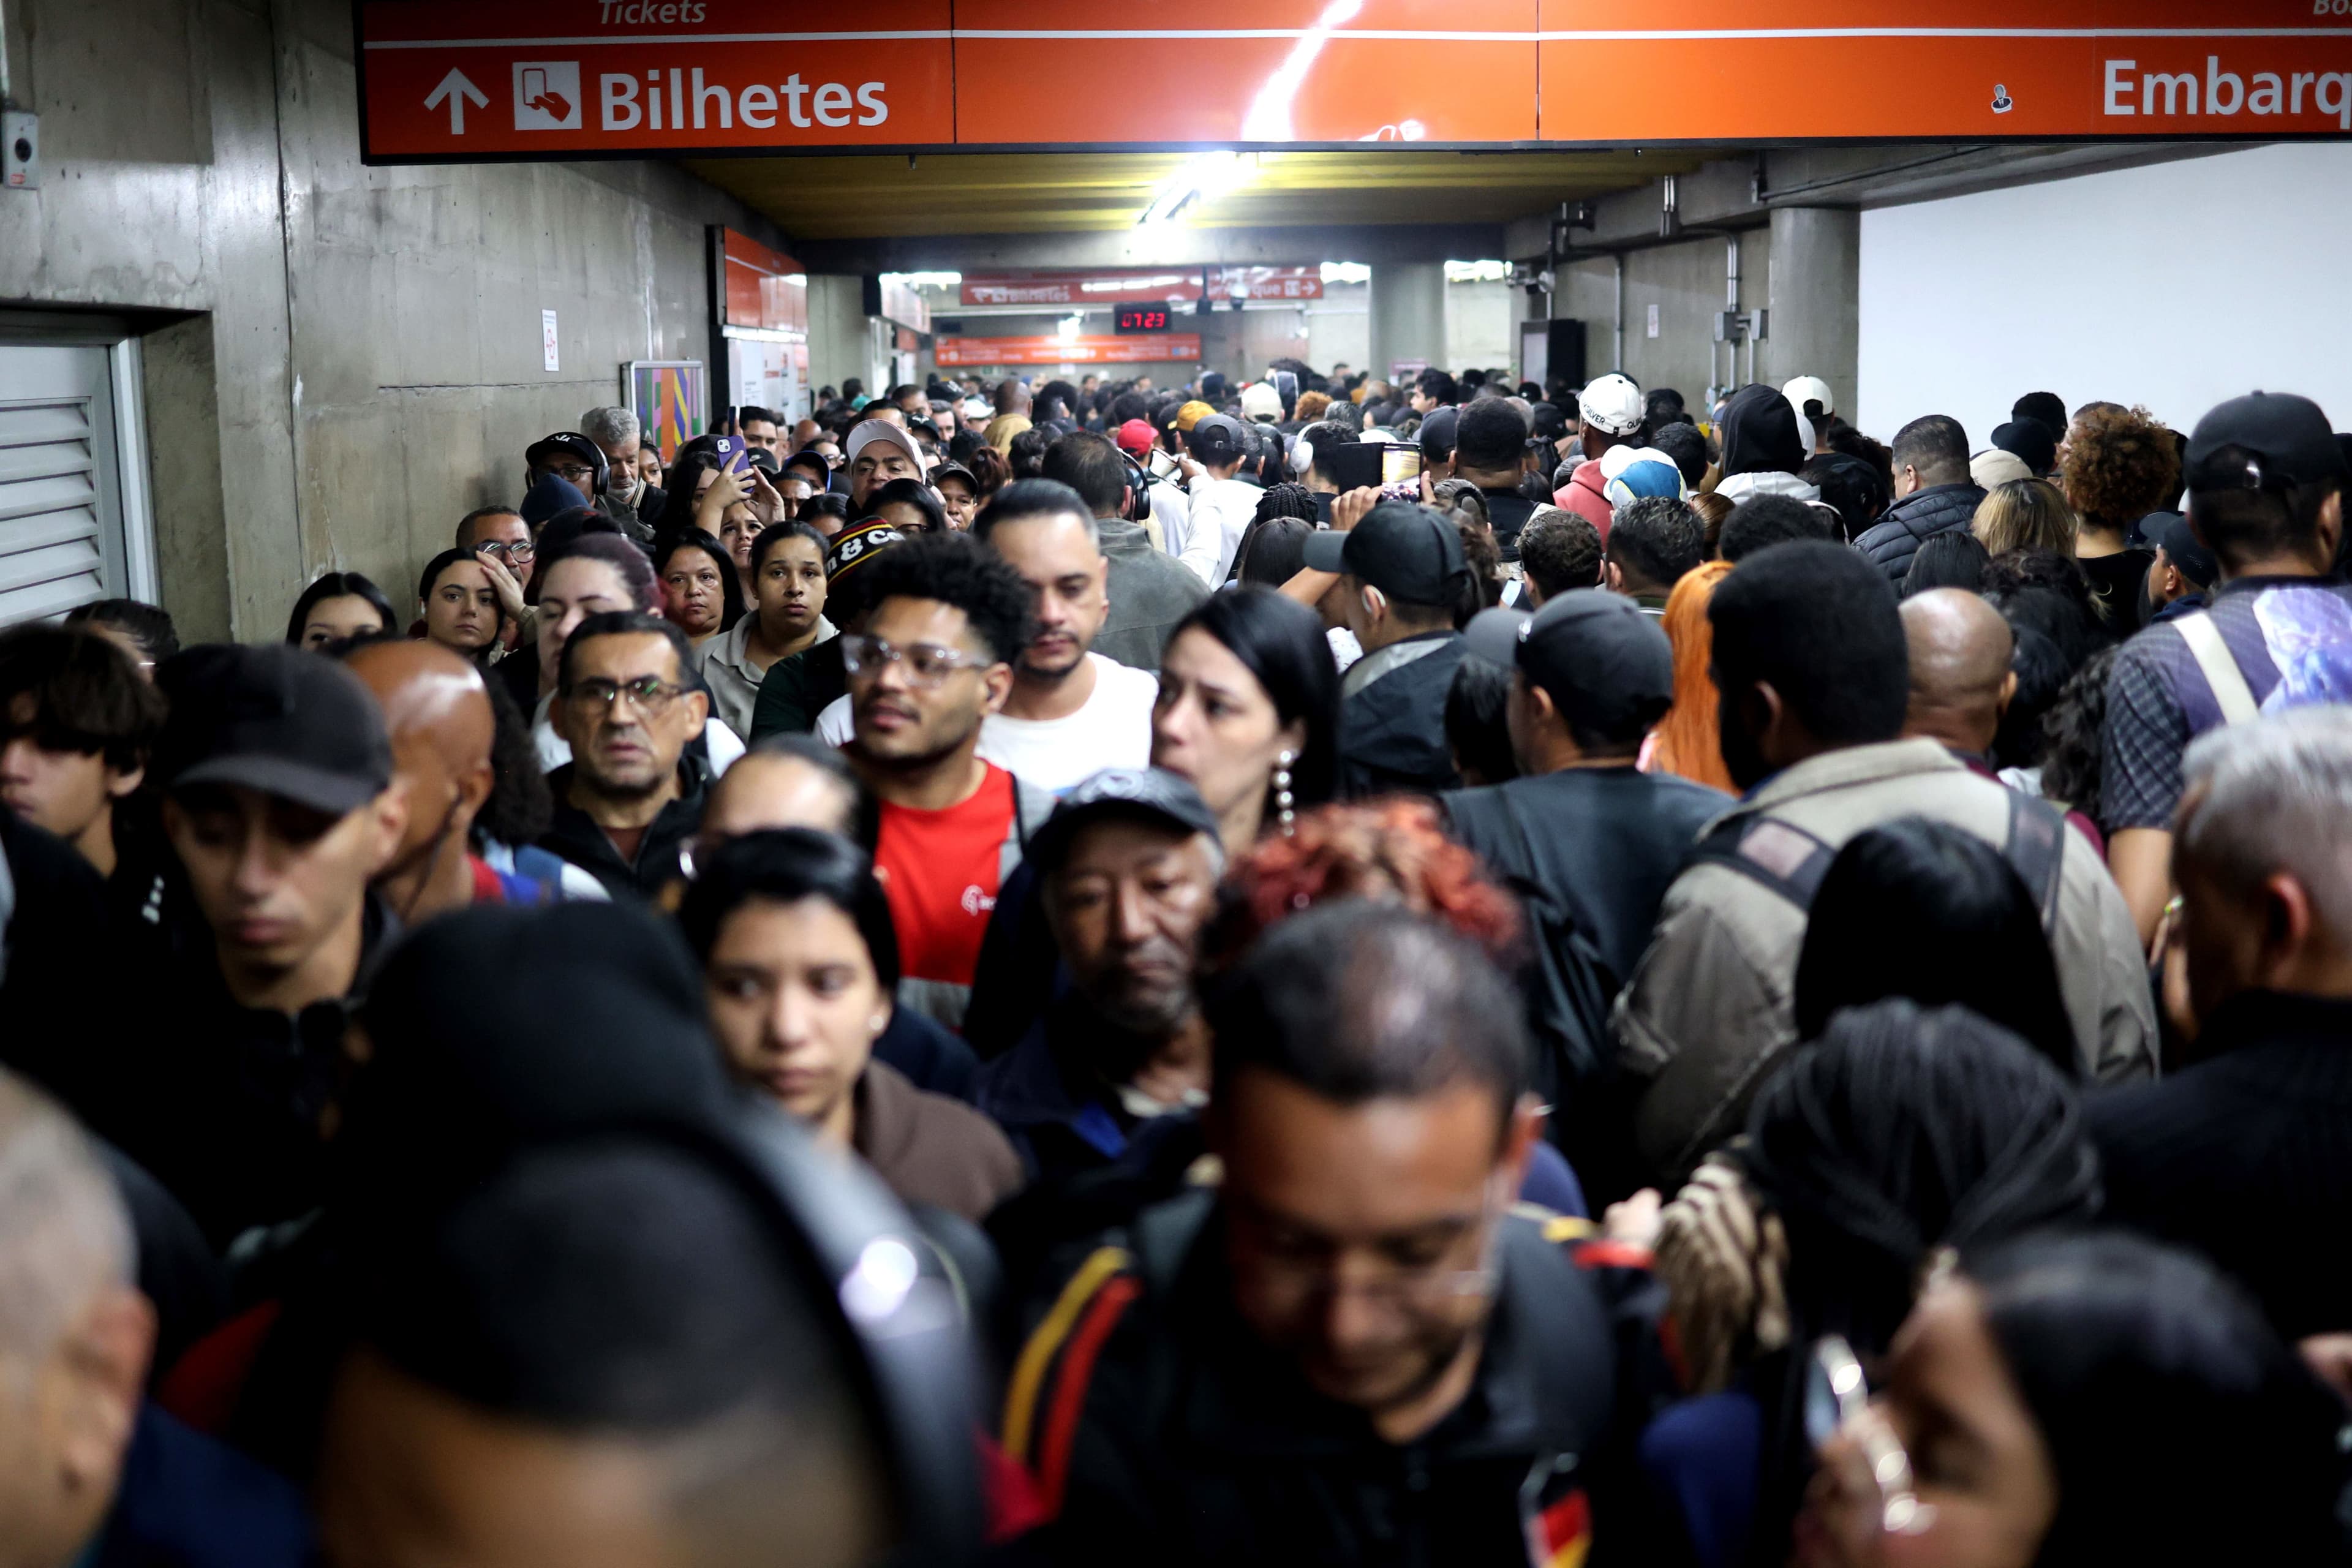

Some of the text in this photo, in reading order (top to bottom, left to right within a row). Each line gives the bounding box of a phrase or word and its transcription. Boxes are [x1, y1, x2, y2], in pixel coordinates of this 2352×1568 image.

[598, 0, 706, 24] Tickets
[600, 67, 889, 131] Bilhetes
[2104, 56, 2351, 129] Embarq
[840, 538, 864, 561] &
